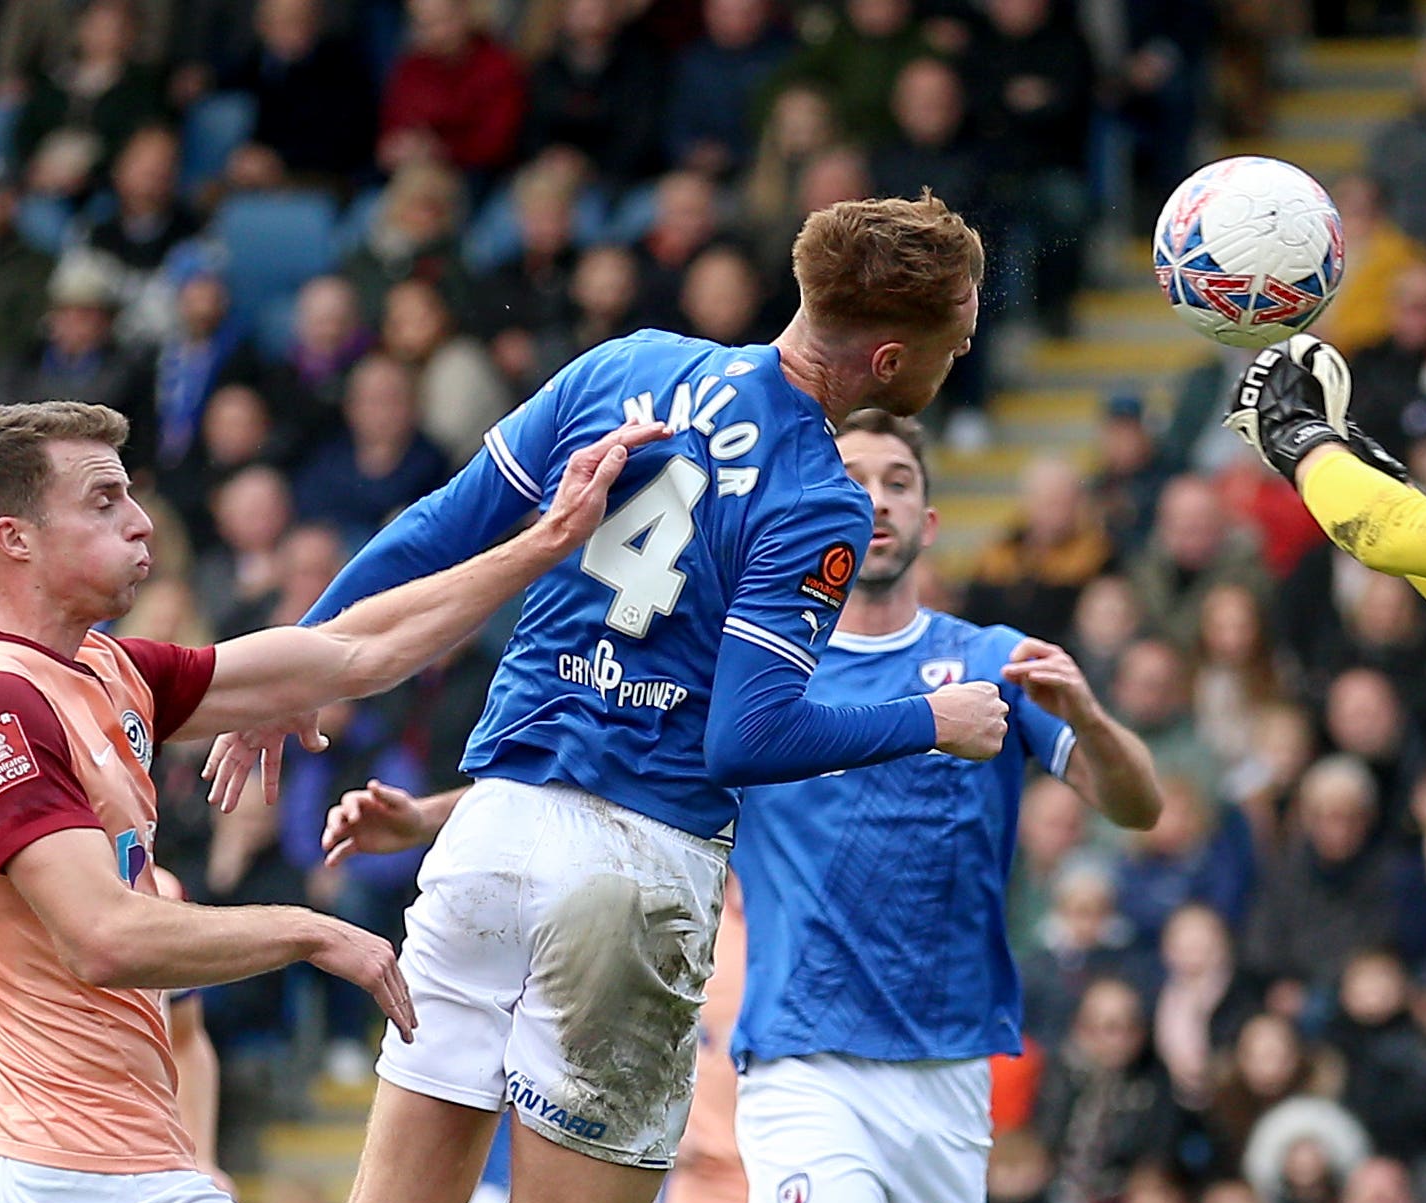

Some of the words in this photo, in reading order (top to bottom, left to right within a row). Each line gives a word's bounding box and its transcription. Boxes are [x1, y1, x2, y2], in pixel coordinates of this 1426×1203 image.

[580, 453, 710, 640] 4
[618, 681, 688, 711] POWER
[5, 762, 31, 780] CUP
[508, 1071, 607, 1140] ANYARD
